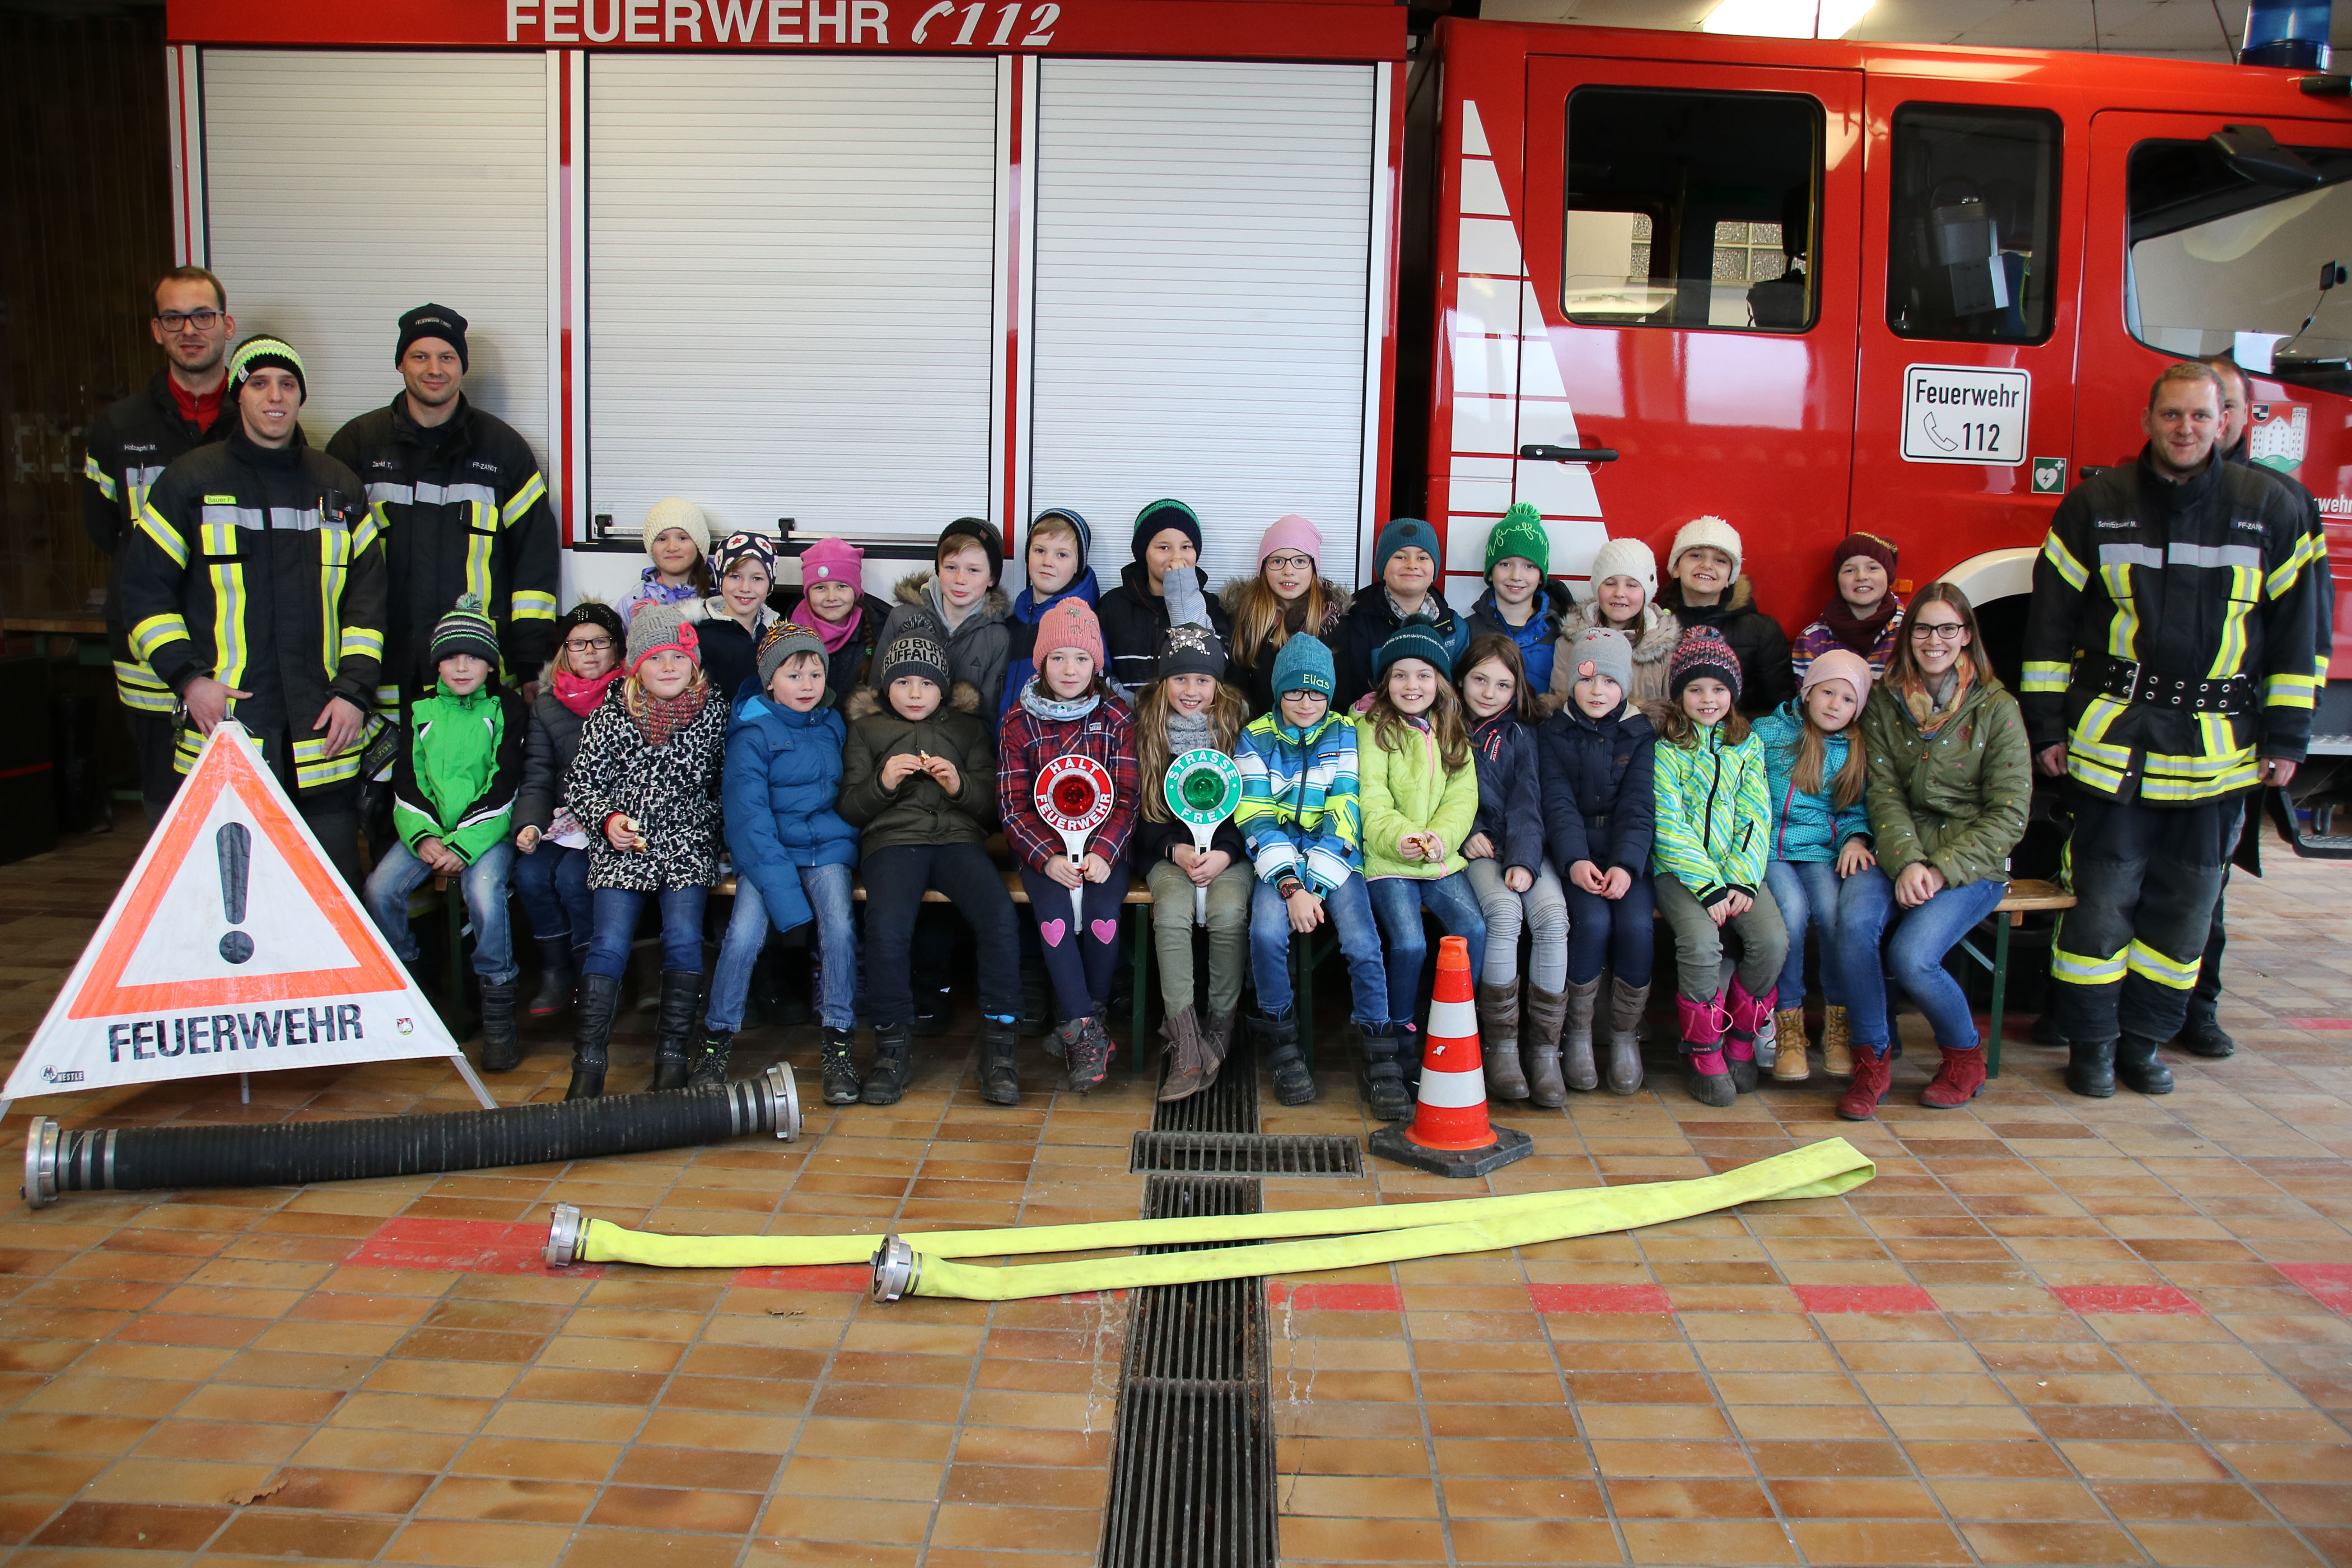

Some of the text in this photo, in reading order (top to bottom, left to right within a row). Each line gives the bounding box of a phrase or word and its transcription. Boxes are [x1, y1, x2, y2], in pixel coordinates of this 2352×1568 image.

[507, 0, 1060, 46] FEUERWEHR 112
[1916, 379, 2019, 408] Feuerwehr
[1963, 422, 2000, 451] 112
[2313, 493, 2352, 514] wehr
[884, 648, 939, 670] BUFFALO
[1303, 673, 1331, 690] Elias
[1049, 758, 1100, 774] HALT
[1168, 751, 1238, 781] STRASSE
[1037, 793, 1111, 830] FEUERWEHR
[1180, 807, 1226, 823] FREI
[108, 1004, 364, 1062] FEUERWEHR
